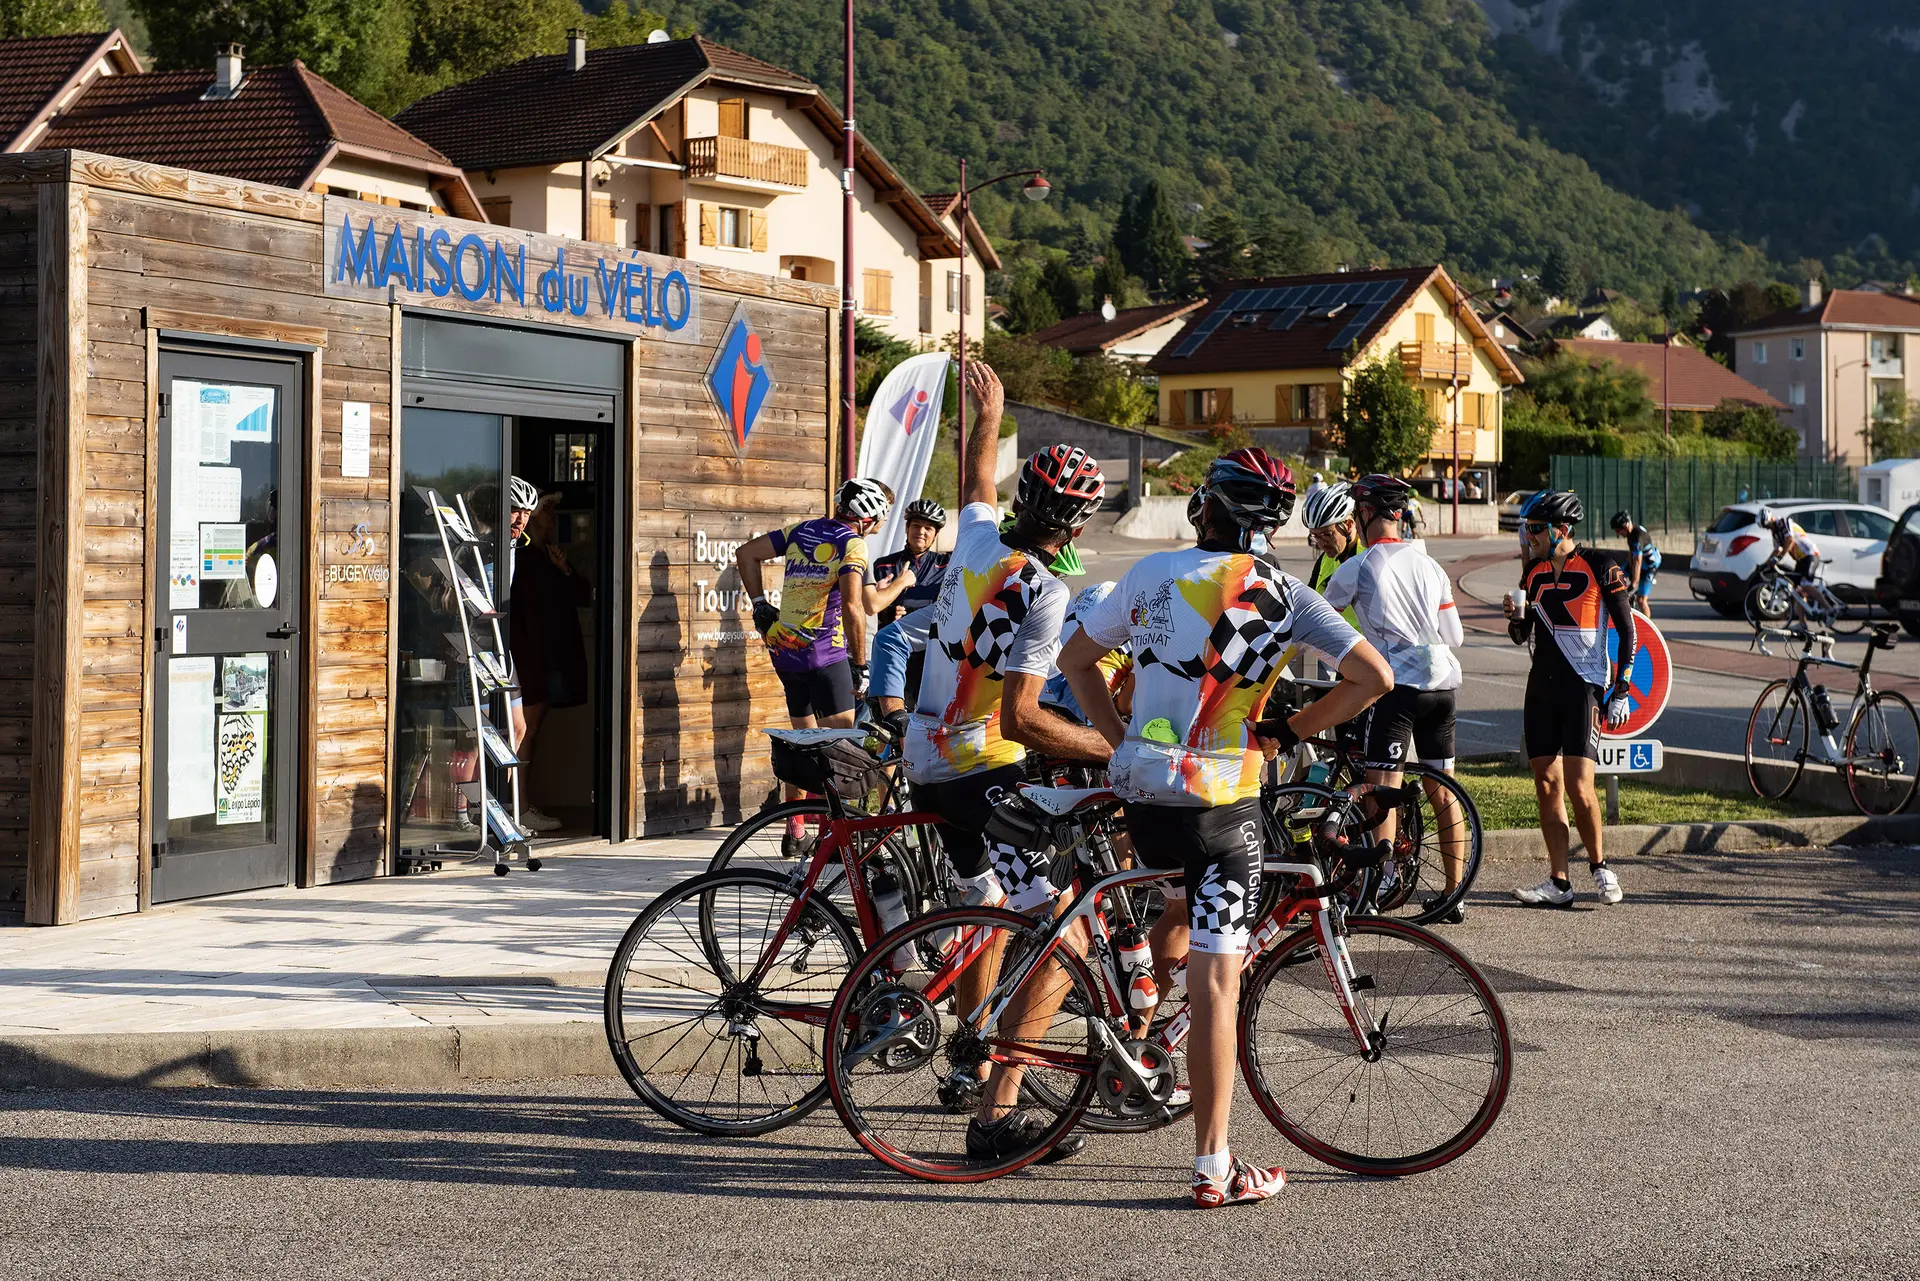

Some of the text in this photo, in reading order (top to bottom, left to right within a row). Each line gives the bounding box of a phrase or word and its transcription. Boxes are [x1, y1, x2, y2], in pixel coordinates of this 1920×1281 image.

[338, 212, 691, 330] MAISON du VÉLO
[1320, 944, 1348, 1007] Bianchi
